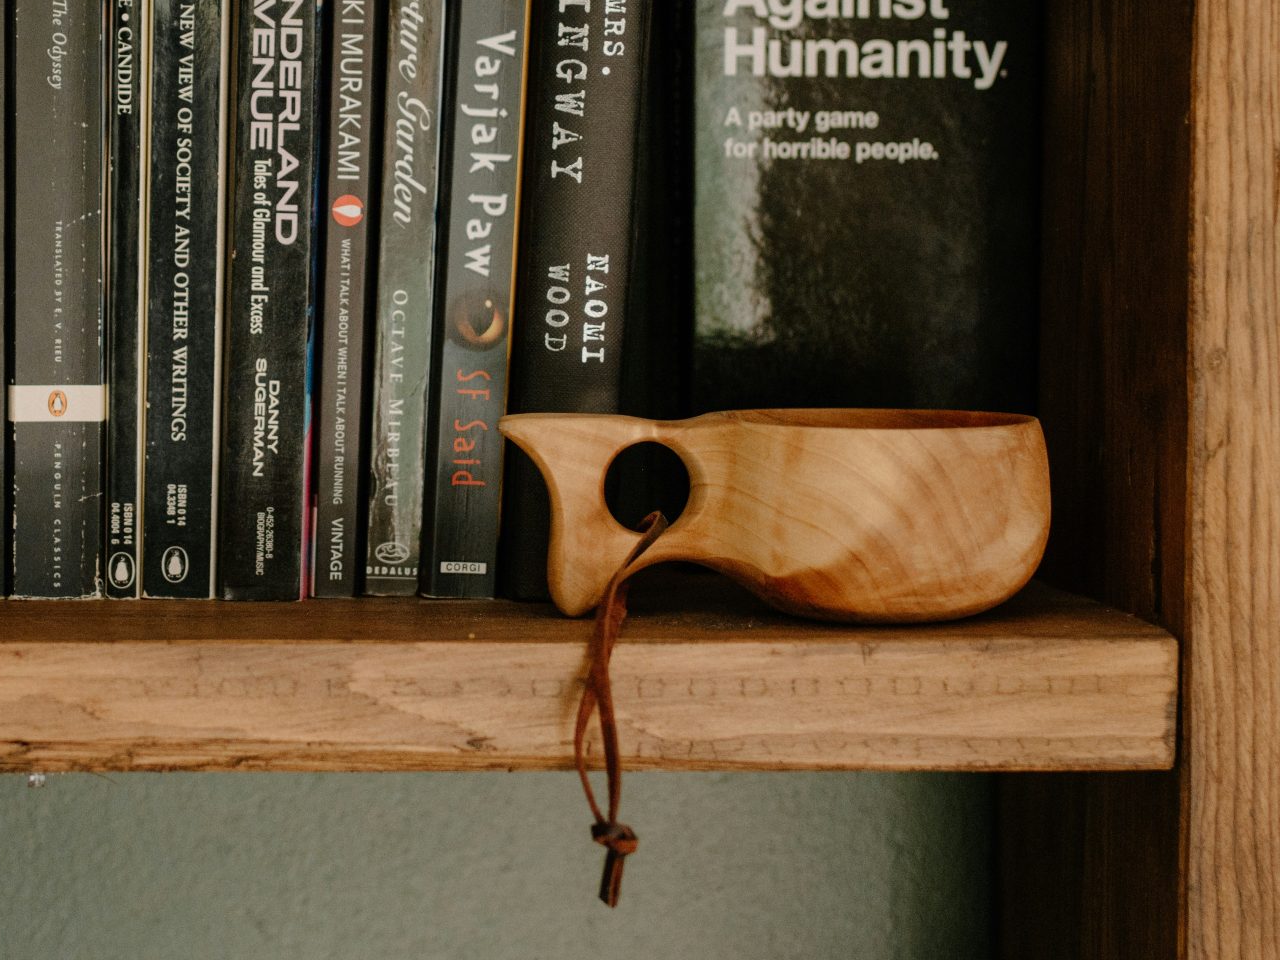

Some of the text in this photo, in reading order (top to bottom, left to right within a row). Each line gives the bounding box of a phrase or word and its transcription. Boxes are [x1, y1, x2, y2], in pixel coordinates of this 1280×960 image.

[47, 32, 67, 90] Odyssey
[117, 27, 133, 115] CANDIDE
[177, 107, 193, 135] OF
[337, 33, 364, 181] MURAKAMI
[749, 107, 879, 133] party game
[763, 137, 850, 159] horrible
[175, 138, 192, 221] SOCIETY
[393, 91, 431, 229] Garden
[461, 30, 517, 277] Varjak Paw
[54, 220, 62, 286] TRANSLATED
[250, 158, 272, 335] Tales and Excess
[173, 271, 190, 341] OTHER
[544, 263, 570, 352] WOOD
[582, 253, 610, 363] NAOMI
[171, 345, 188, 442] WRITINGS
[252, 358, 267, 477] SUGERMAN
[267, 379, 280, 455] DANNY
[385, 289, 408, 507] OCTAVE MIRBEAU
[451, 368, 492, 487] SF Said
[53, 444, 62, 588] PENGUIN CLASSICS
[333, 455, 344, 505] RUNNING
[329, 518, 344, 581] VINTAGE
[366, 566, 418, 576] DEDALUS
[445, 563, 481, 572] CORGI
